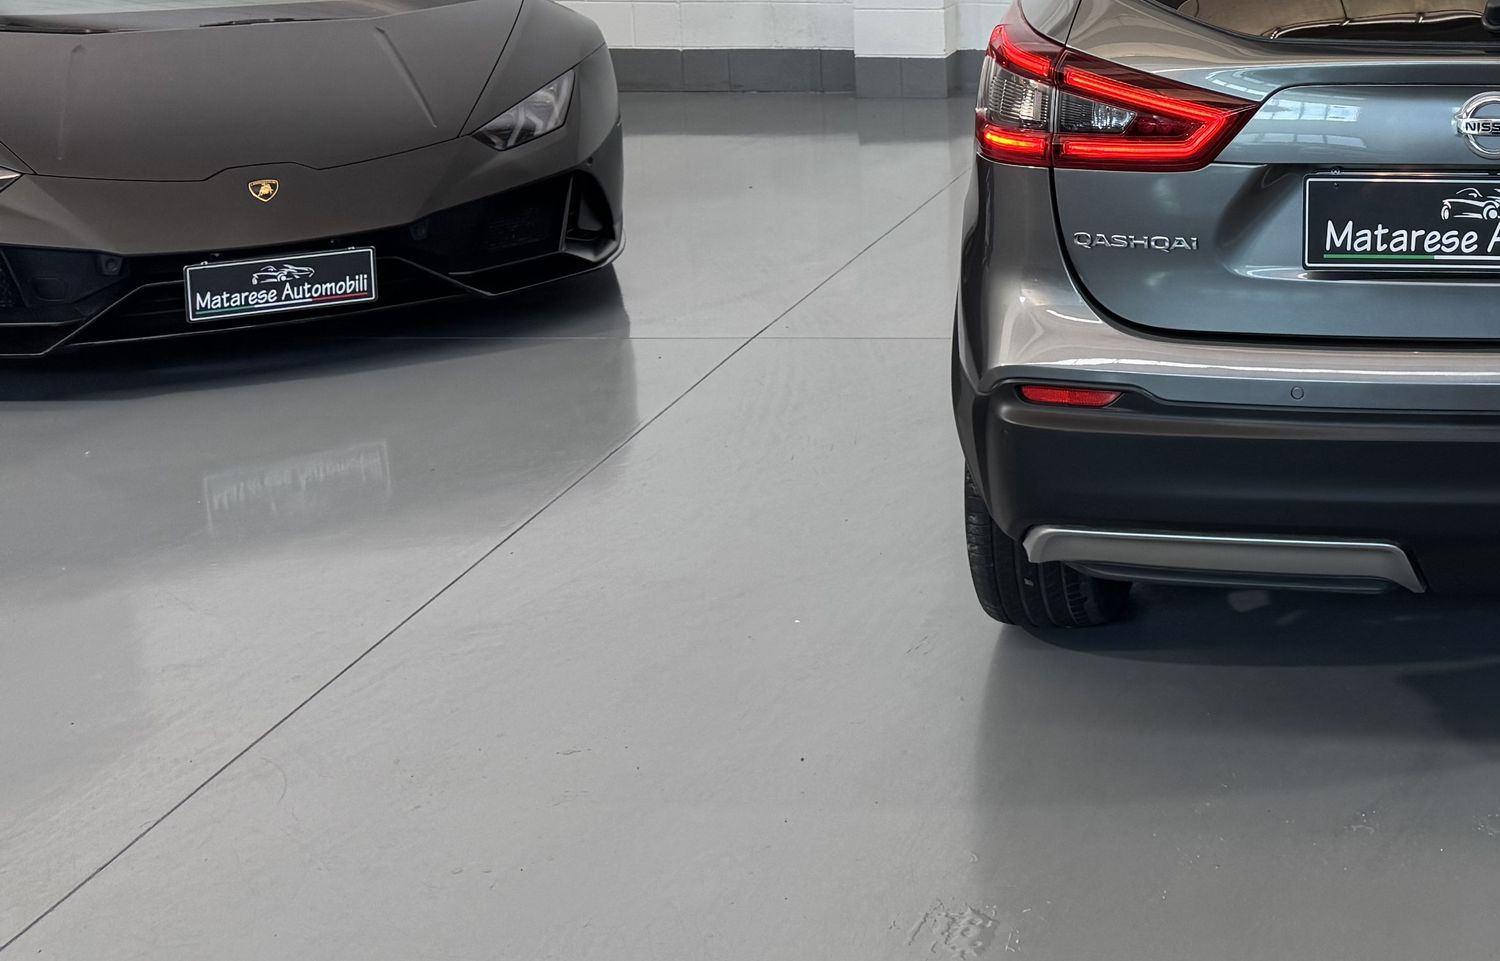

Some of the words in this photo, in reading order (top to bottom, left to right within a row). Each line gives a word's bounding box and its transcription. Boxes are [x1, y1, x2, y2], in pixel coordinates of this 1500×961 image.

[1073, 231, 1199, 253] QASHQAI
[1325, 219, 1478, 254] Matarese
[195, 288, 278, 311] Matarese
[281, 273, 368, 301] Automobili
